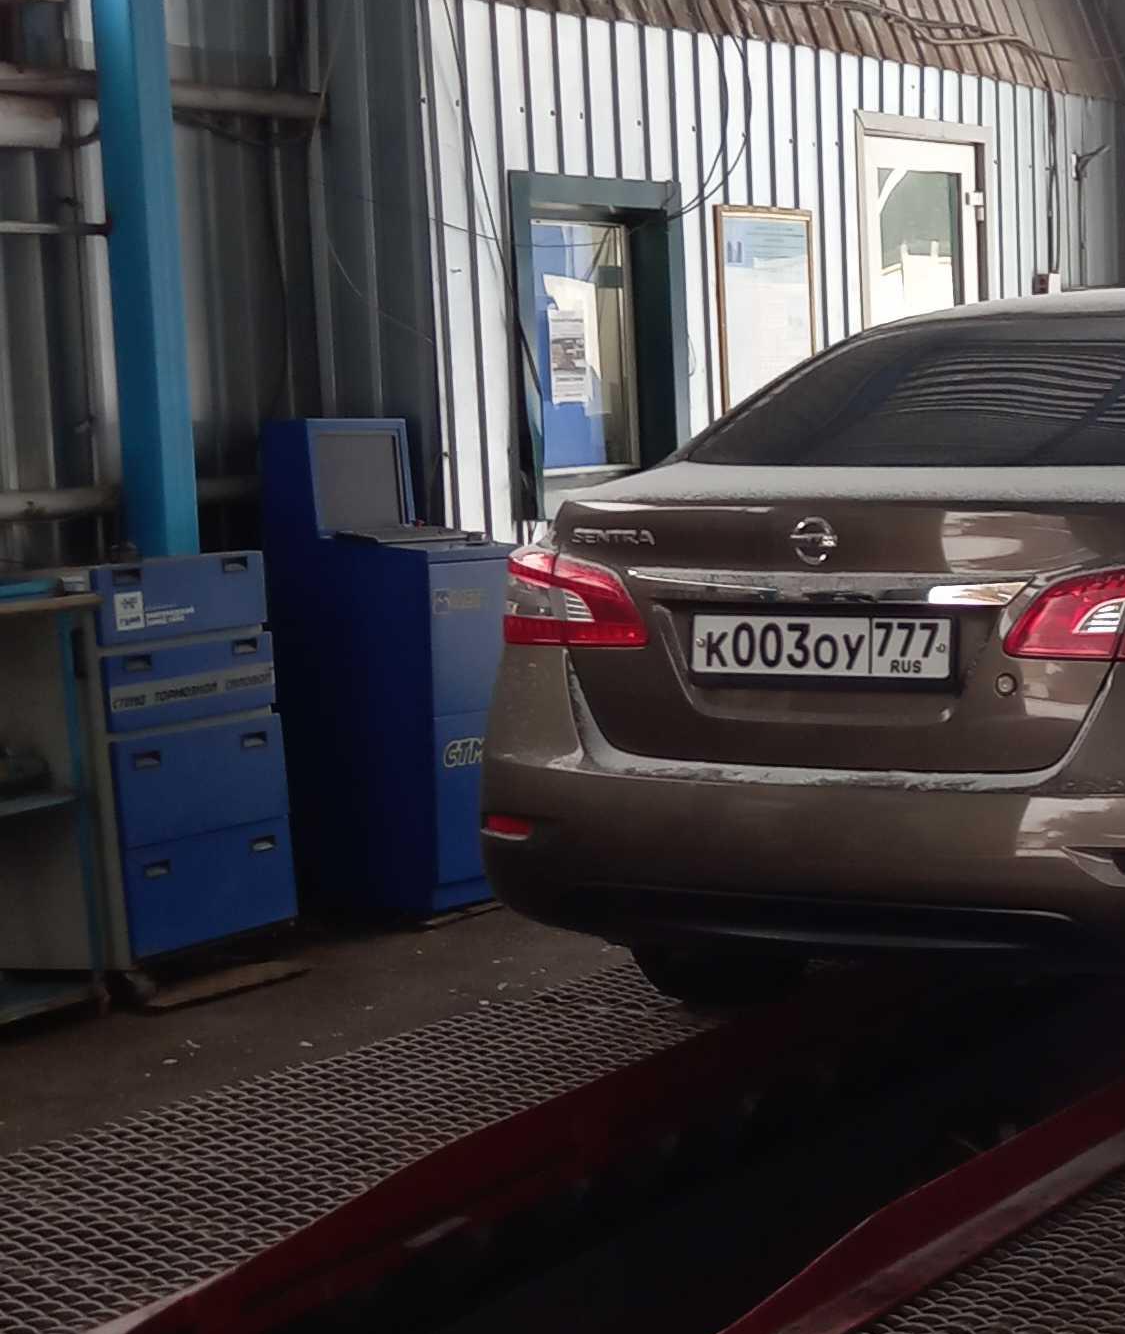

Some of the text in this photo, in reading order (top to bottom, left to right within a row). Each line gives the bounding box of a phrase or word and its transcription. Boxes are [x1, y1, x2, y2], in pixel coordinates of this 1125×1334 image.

[572, 528, 655, 546] SENTRA
[875, 622, 939, 658] 777
[890, 660, 922, 674] RUS
